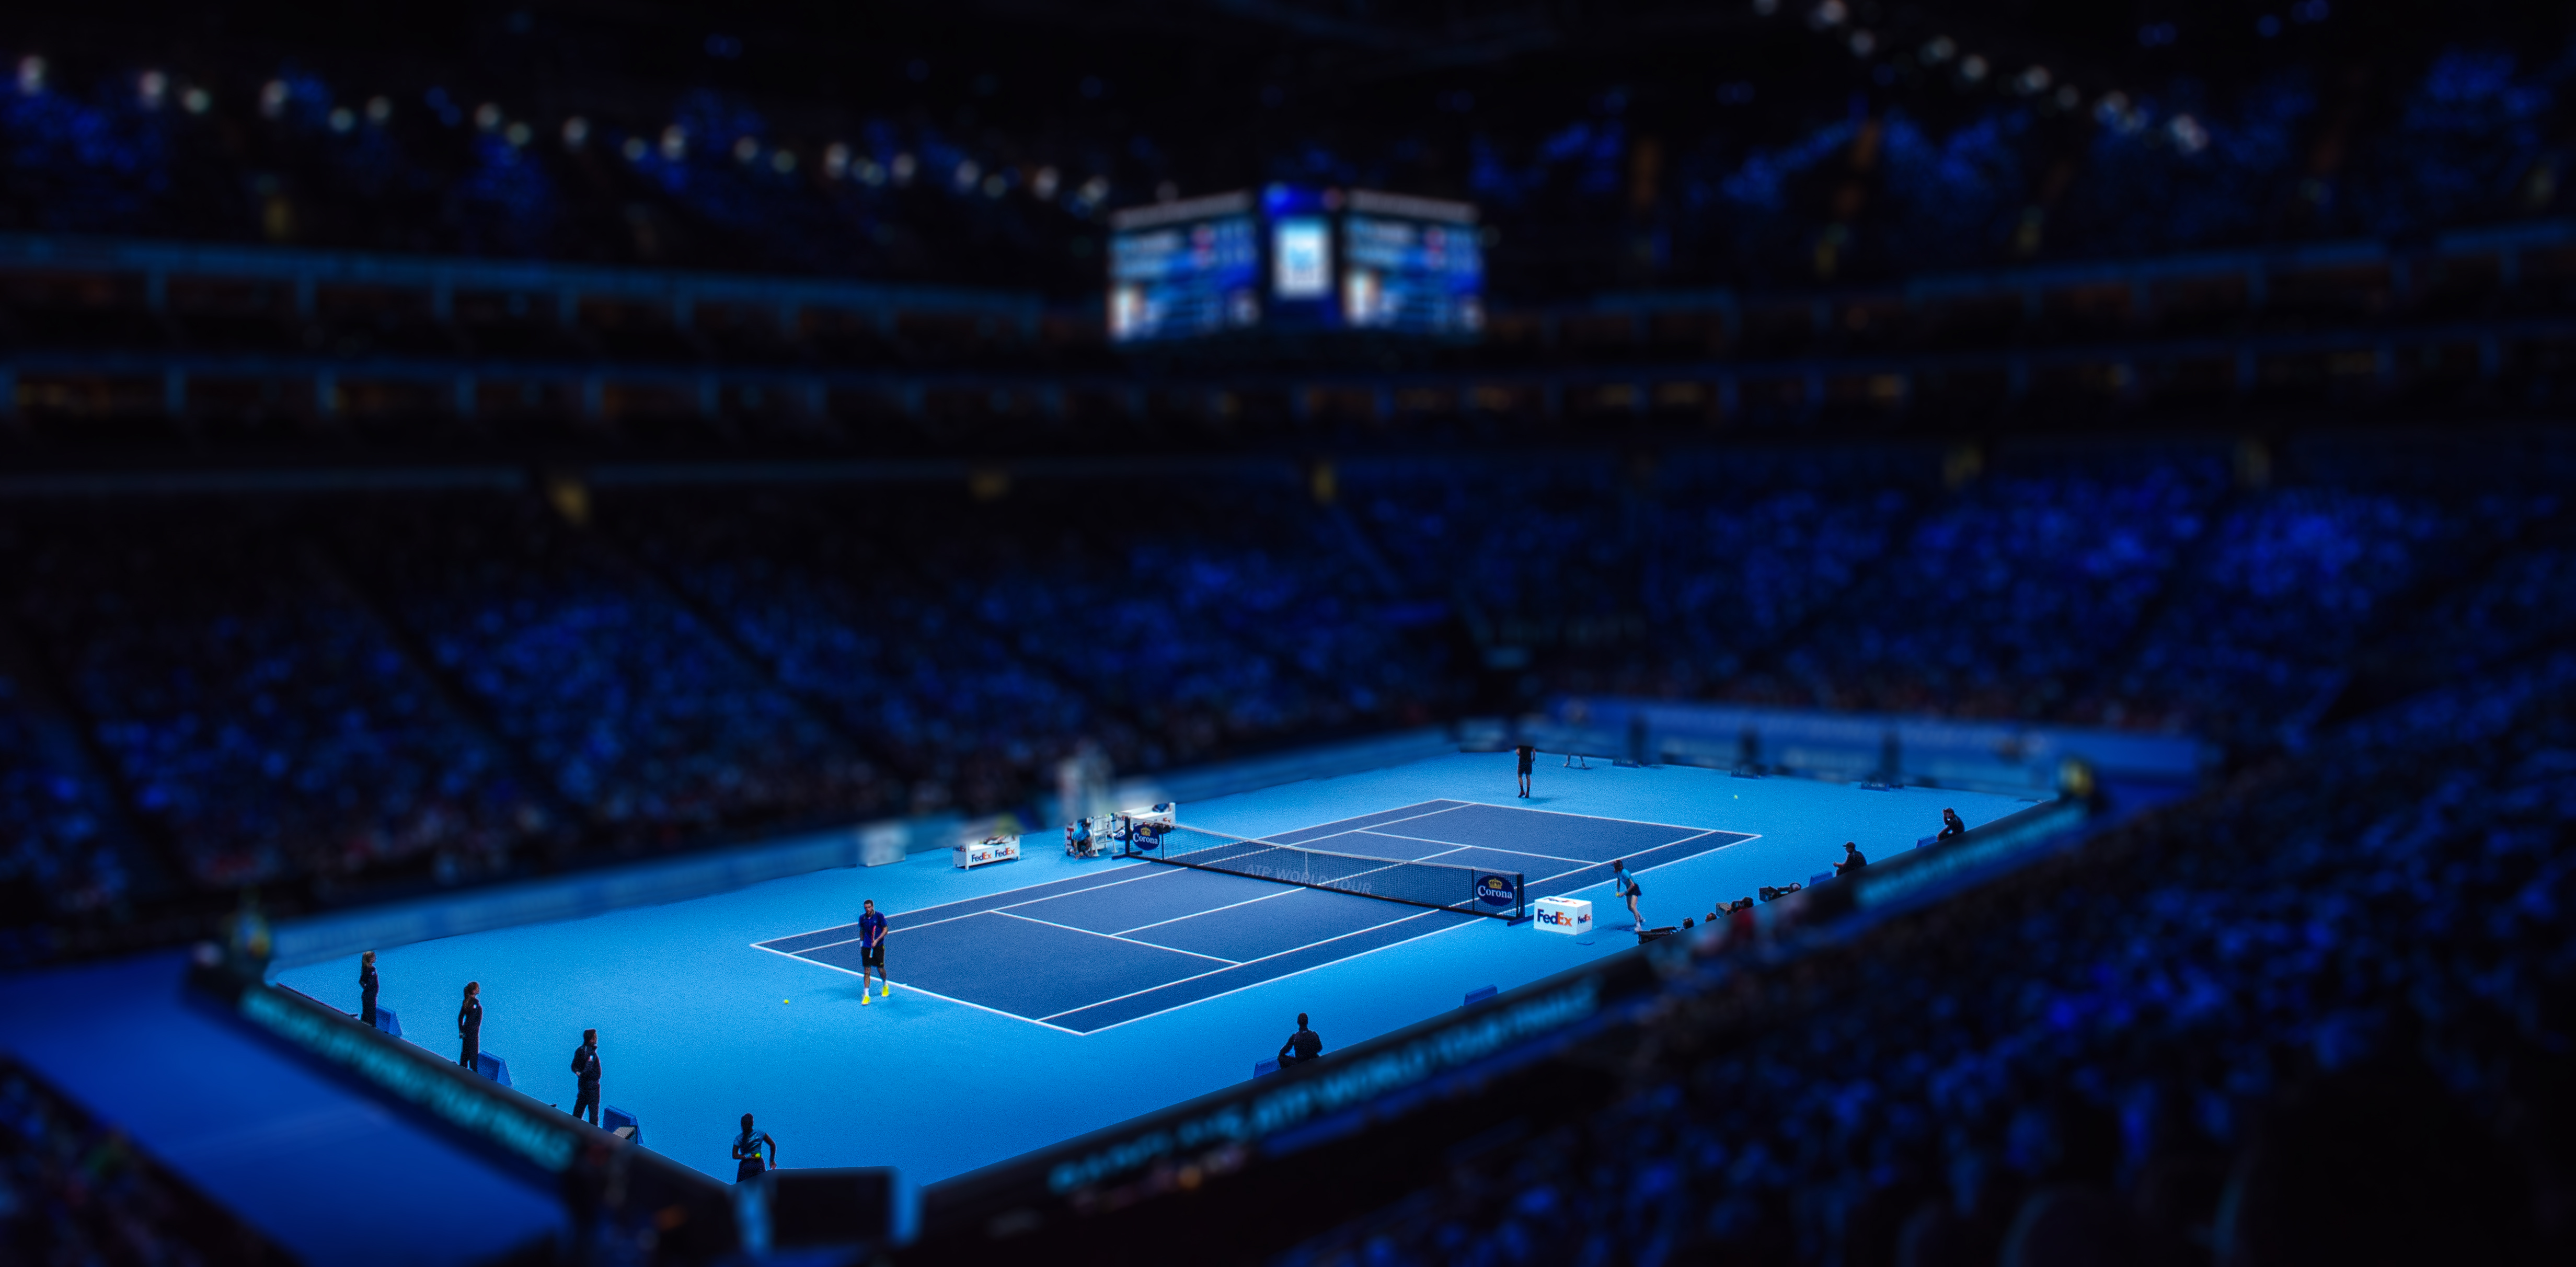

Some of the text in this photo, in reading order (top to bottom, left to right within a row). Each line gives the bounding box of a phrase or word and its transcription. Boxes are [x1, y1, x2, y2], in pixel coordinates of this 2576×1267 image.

[1132, 833, 1158, 845] Corona
[971, 847, 1015, 862] FedEx FedEx
[1244, 863, 1373, 894] ATP WORLD TOUR
[1477, 885, 1513, 899] Corona
[1537, 908, 1573, 927] FedEx
[1578, 914, 1591, 924] FedEx
